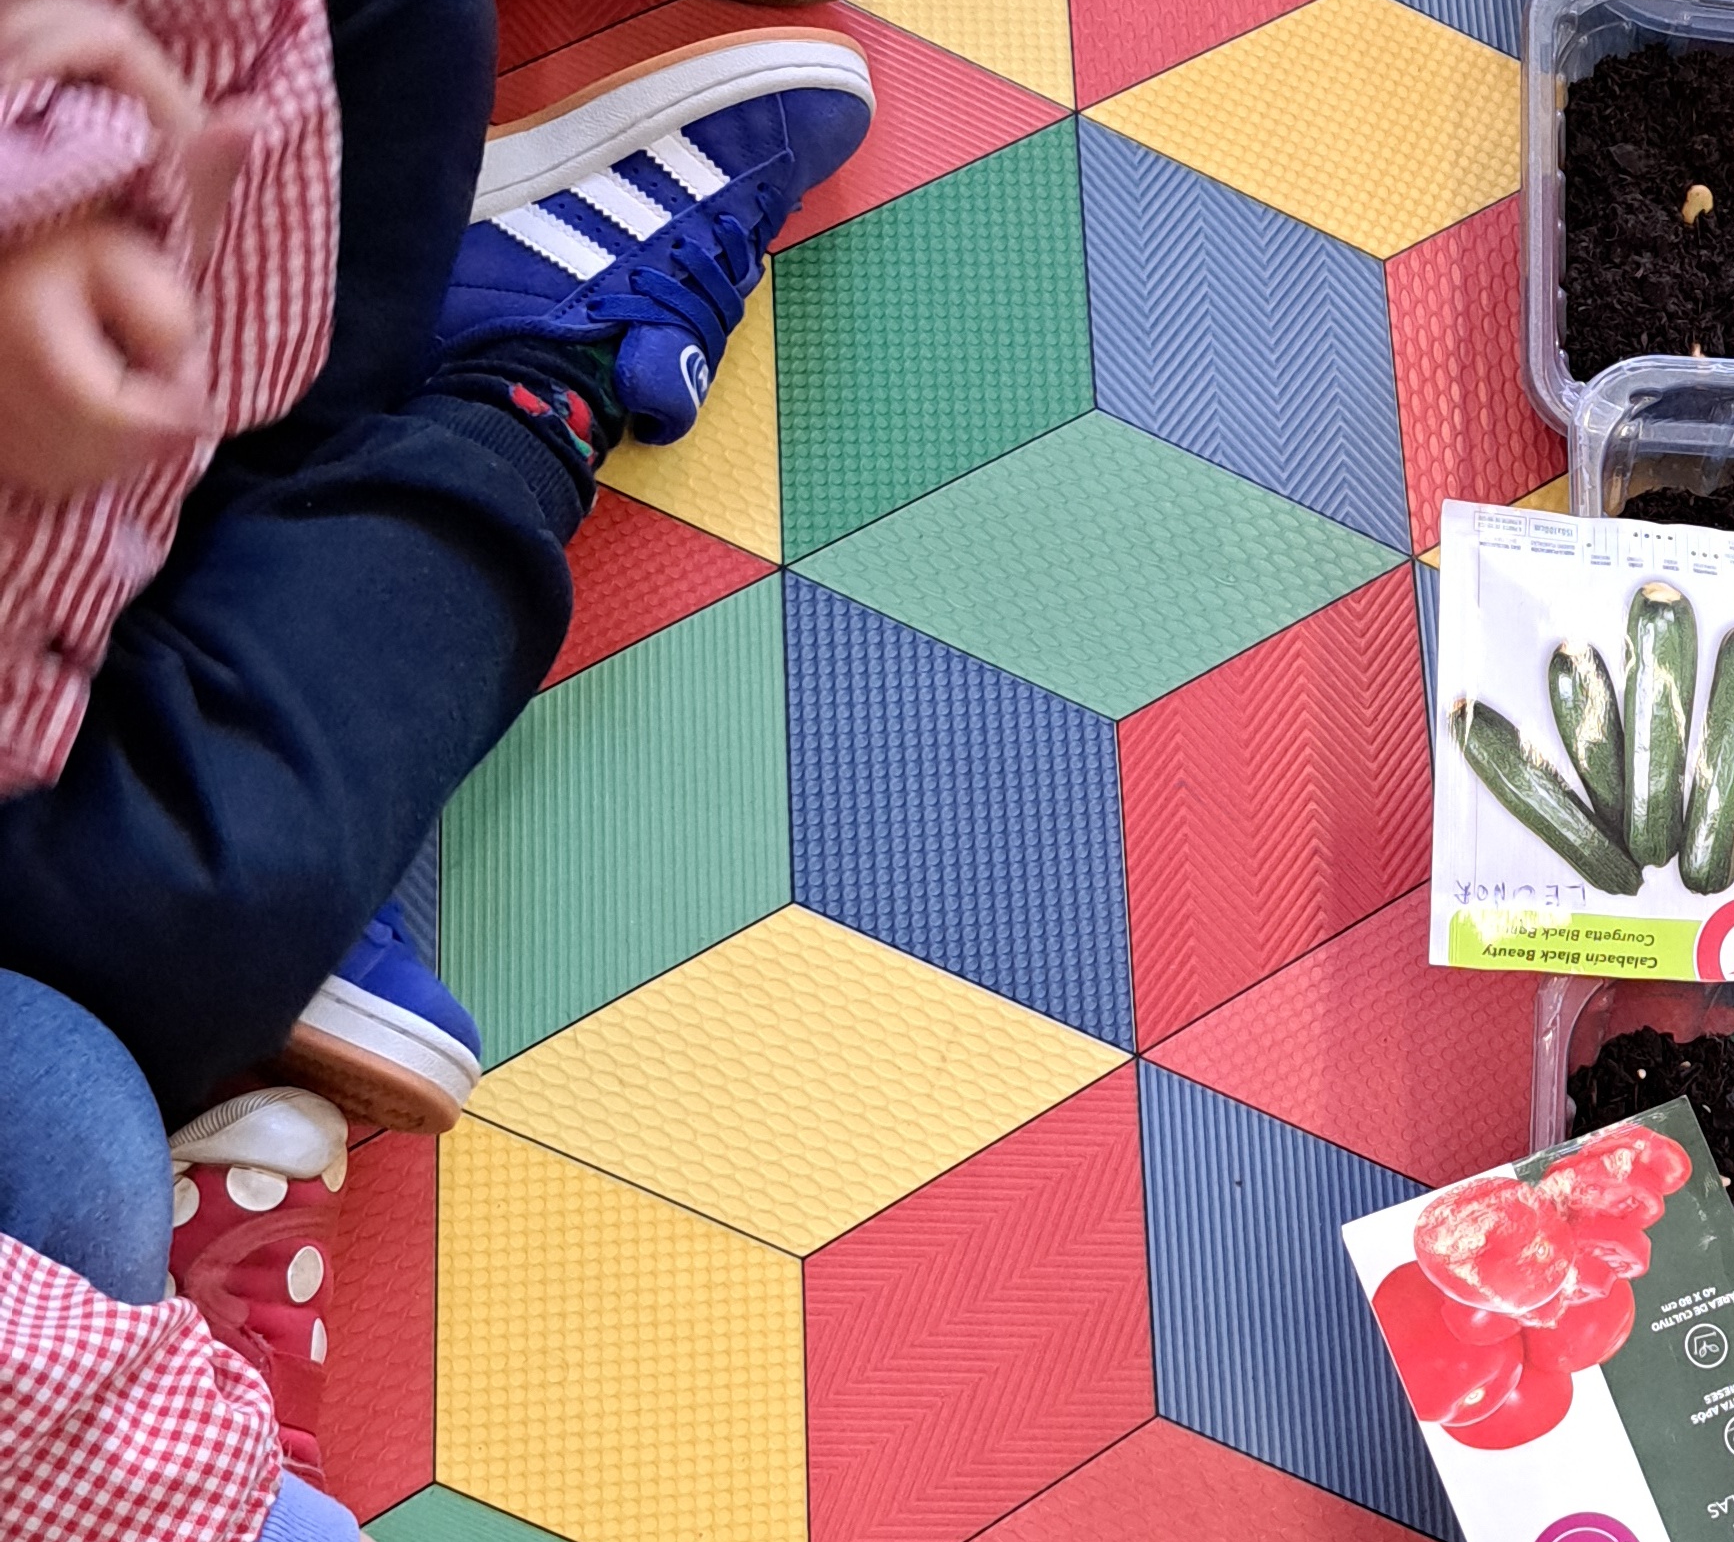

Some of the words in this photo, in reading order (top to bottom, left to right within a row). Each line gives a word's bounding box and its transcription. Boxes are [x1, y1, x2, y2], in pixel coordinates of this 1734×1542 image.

[1541, 927, 1580, 941] Black
[1585, 929, 1655, 946] Courgetta
[1482, 944, 1536, 962] Beauty
[1540, 950, 1581, 964] Black
[1585, 953, 1658, 969] Calabacín
[1661, 1302, 1678, 1313] cm
[1694, 1302, 1708, 1316] DE
[1651, 1310, 1693, 1332] CULTIVO
[1690, 1405, 1719, 1425] APÓS
